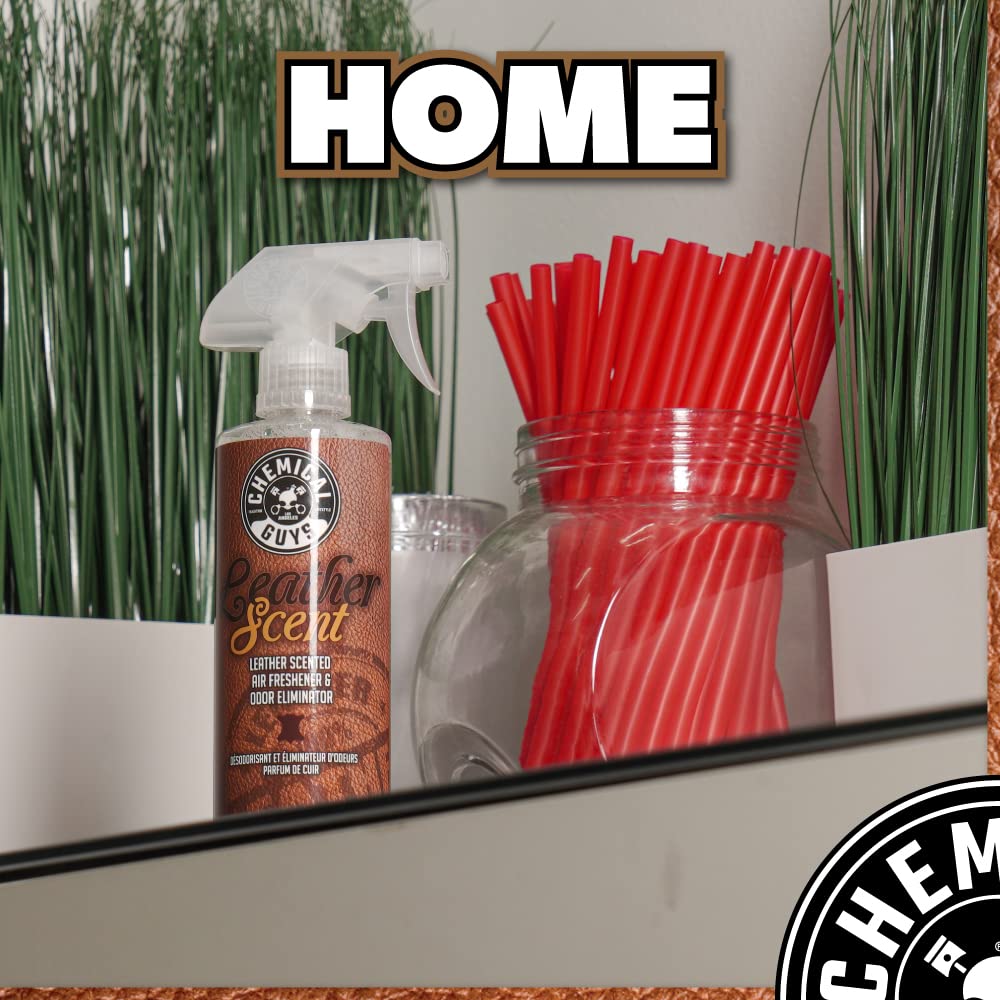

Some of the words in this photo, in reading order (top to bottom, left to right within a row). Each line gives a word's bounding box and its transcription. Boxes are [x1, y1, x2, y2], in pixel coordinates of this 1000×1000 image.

[248, 457, 331, 504] CHEMICAL
[261, 522, 312, 546] GUYS
[223, 554, 381, 622] Leather
[230, 596, 350, 655] Scent
[250, 656, 287, 671] LEATHER
[290, 655, 331, 669] SCENTED
[252, 674, 266, 688] AIR
[269, 673, 322, 687] FRESHENER
[324, 673, 332, 687] &
[250, 691, 275, 705] ODOR
[277, 690, 333, 704] ELIMINATOR
[273, 753, 280, 763] ET
[282, 750, 326, 763] ÉLIMINATEUR
[327, 752, 358, 764] D'ODEURS
[263, 765, 290, 775] PARFUM
[292, 764, 301, 774] DE
[302, 764, 319, 774] CUIR
